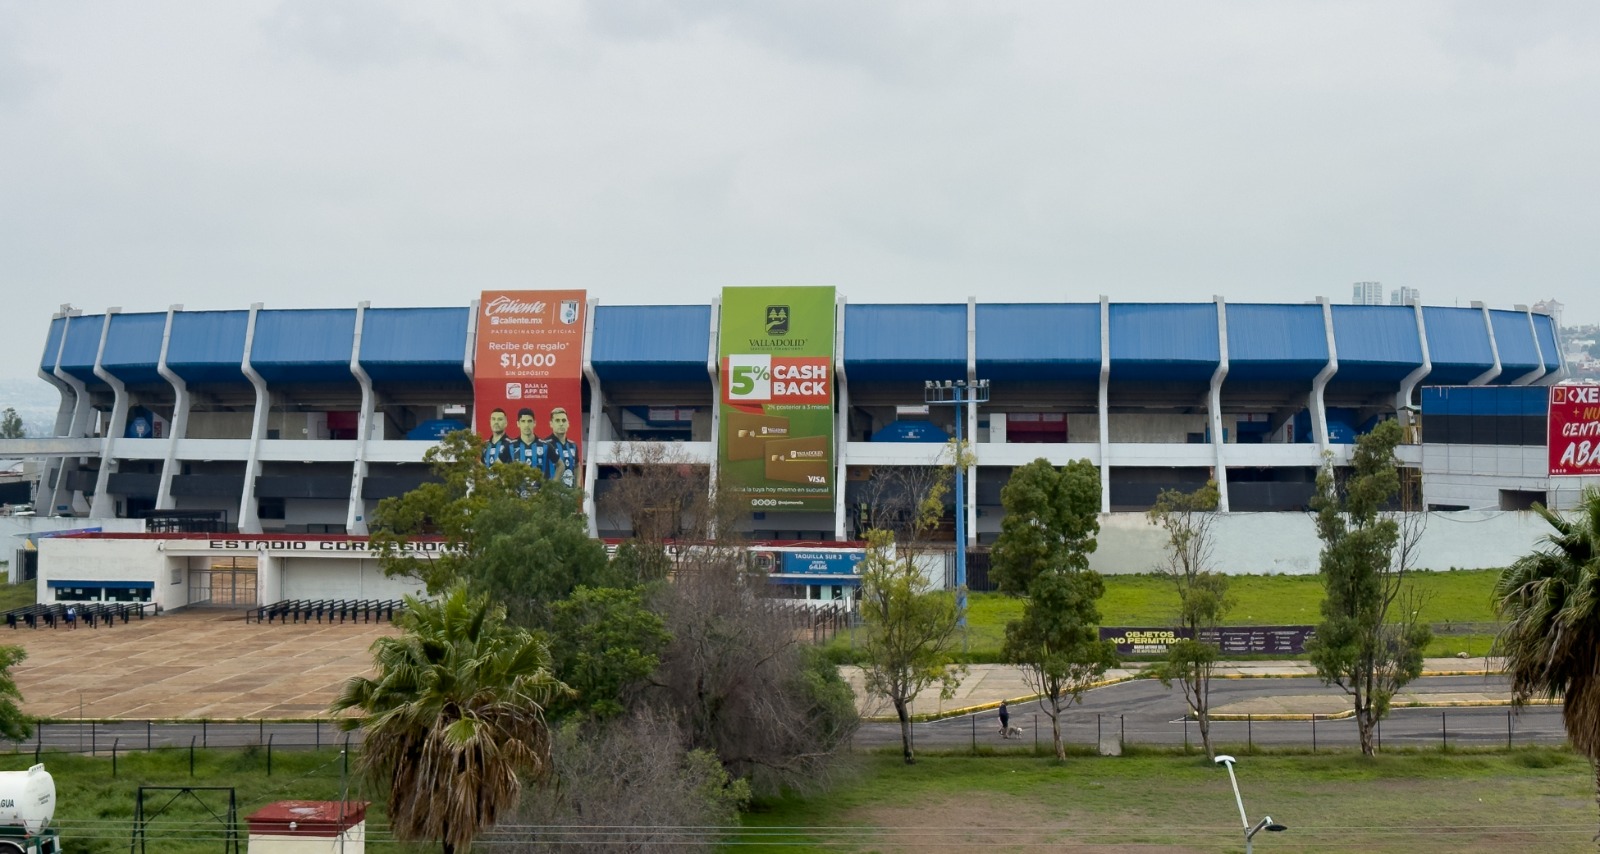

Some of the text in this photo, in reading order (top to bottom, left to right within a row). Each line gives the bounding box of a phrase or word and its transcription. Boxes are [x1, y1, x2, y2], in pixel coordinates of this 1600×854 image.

[485, 296, 546, 316] Caliente
[489, 342, 520, 350] Recibe
[522, 342, 534, 350] de
[749, 339, 805, 347] VALLADOLID
[500, 353, 556, 369] $1,000
[731, 365, 826, 395] 5% CASH
[773, 382, 826, 395] BACK
[1575, 387, 1600, 403] XE
[0, 799, 14, 808] GUA
